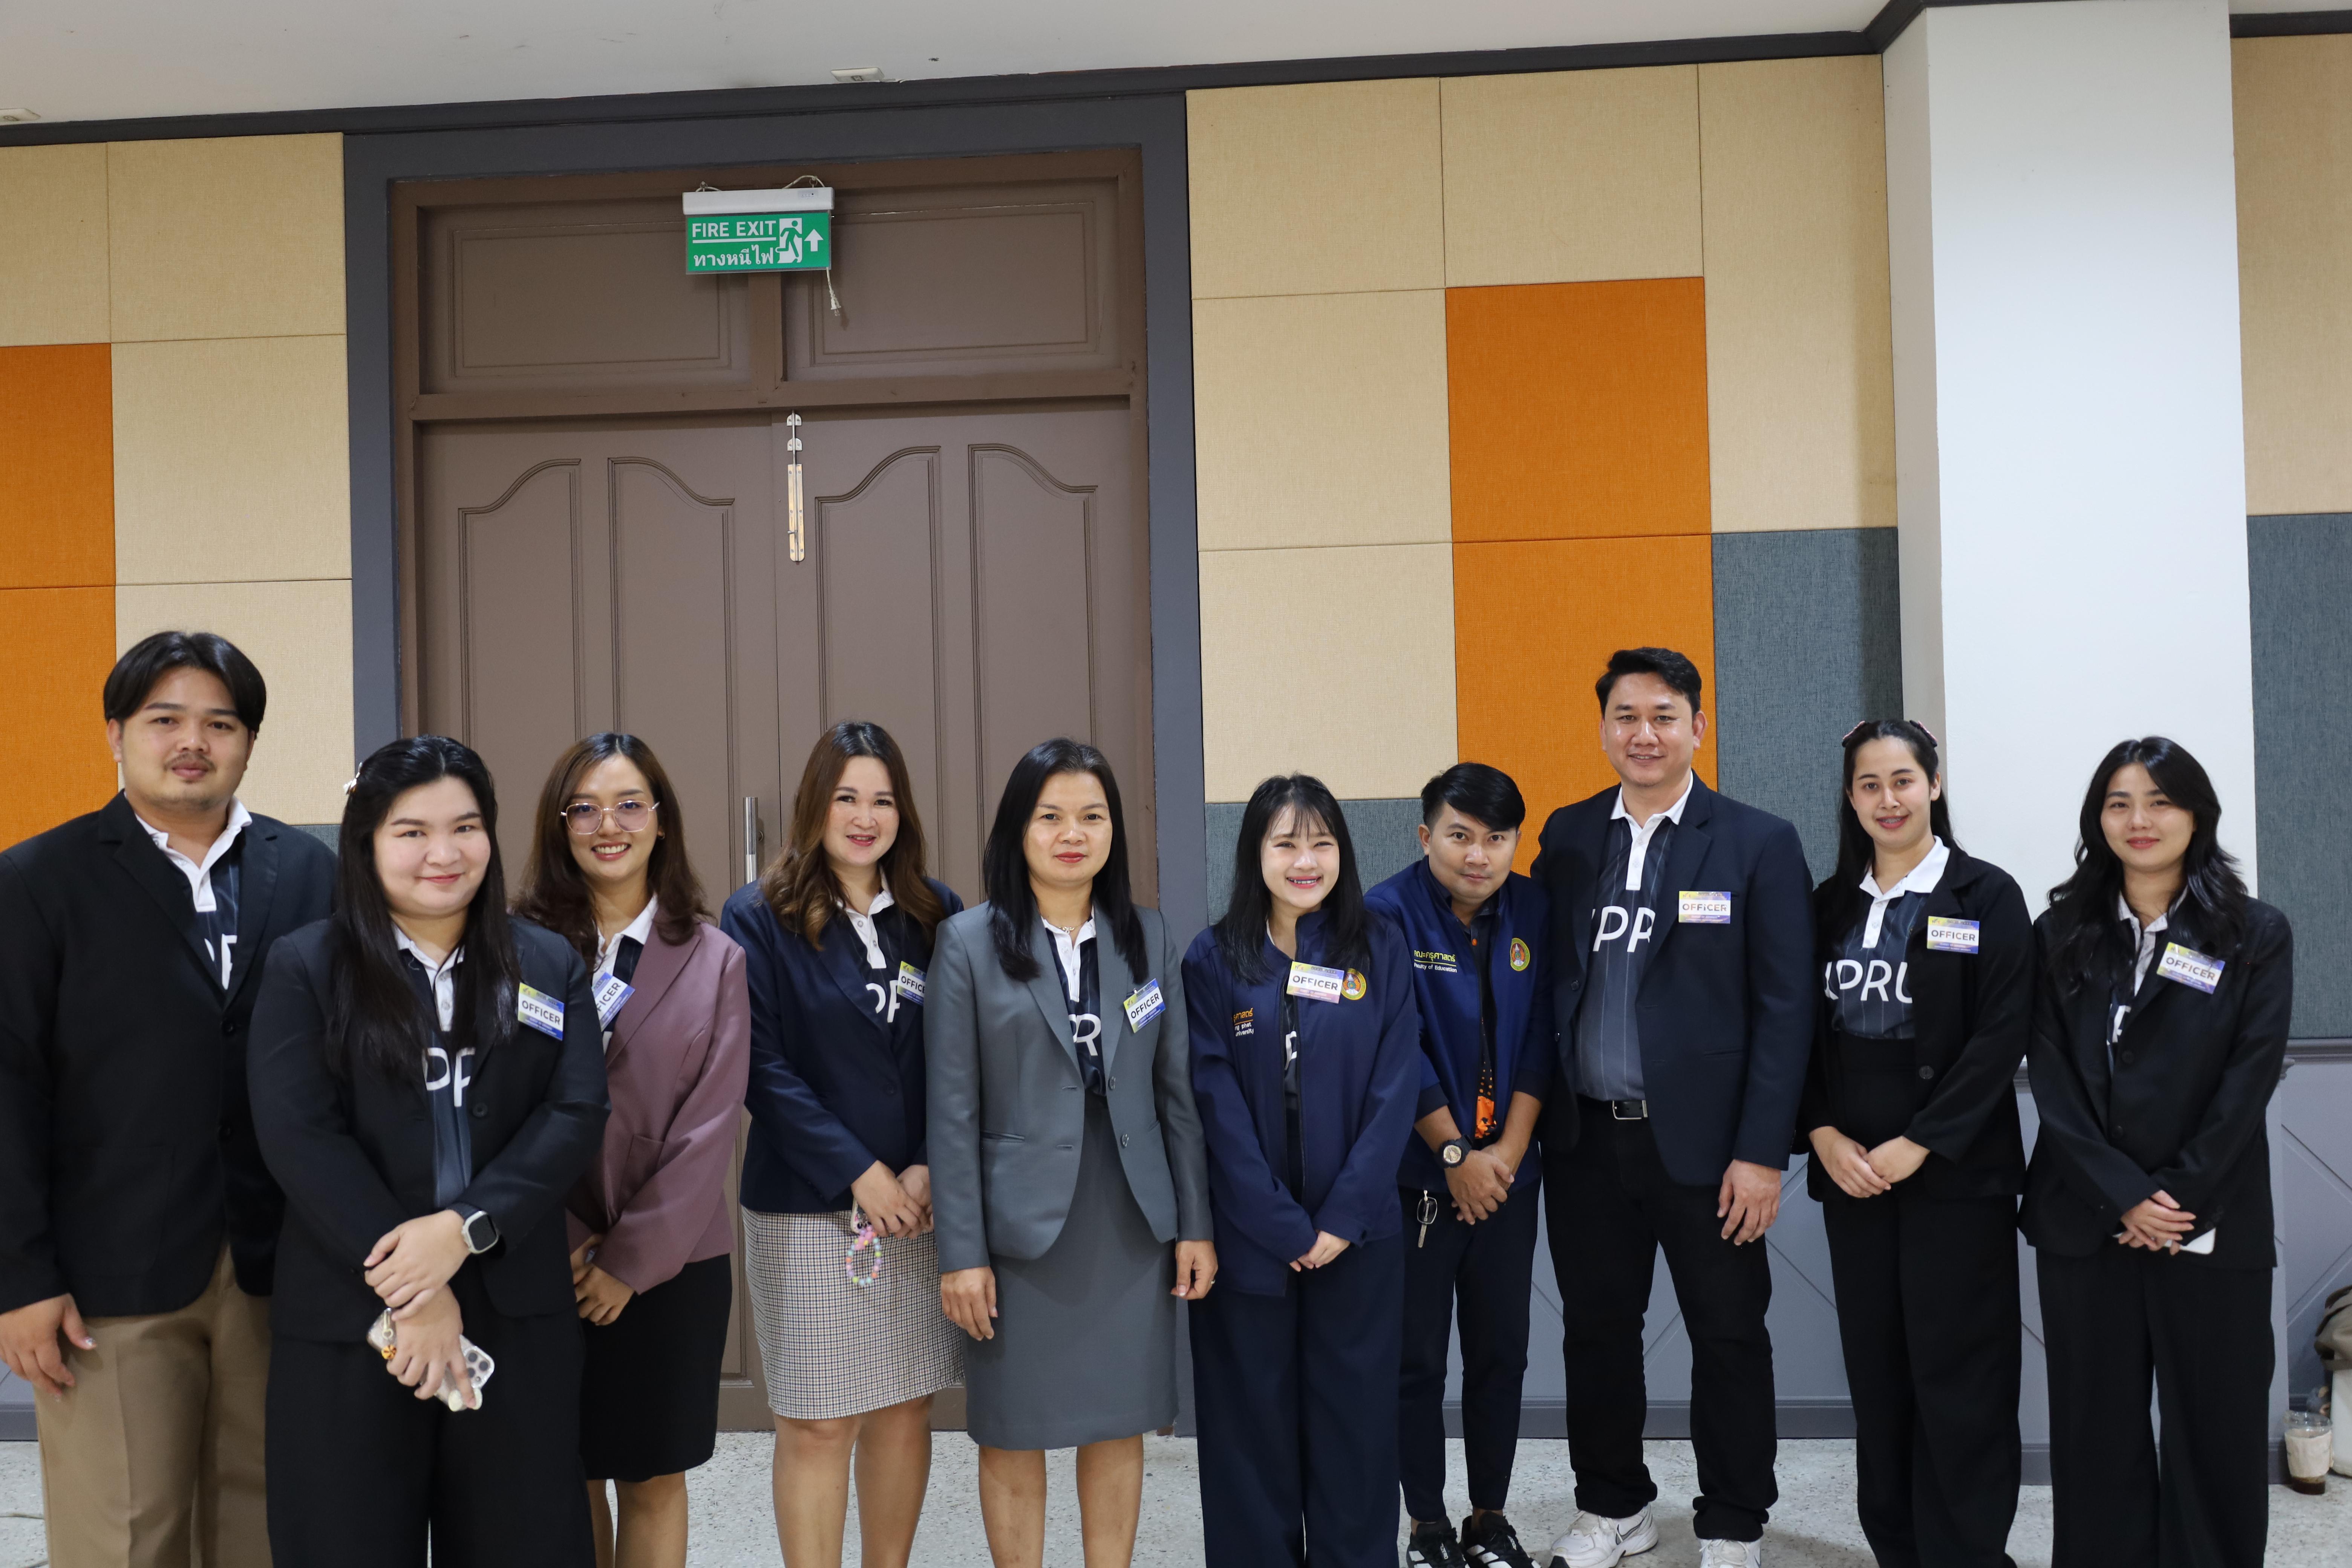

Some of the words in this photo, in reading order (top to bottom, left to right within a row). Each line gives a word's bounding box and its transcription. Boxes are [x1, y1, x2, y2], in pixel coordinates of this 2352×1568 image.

[692, 222, 729, 237] FIRE
[737, 220, 776, 236] EXIT
[694, 244, 773, 267] ทางหนีไฟ
[1591, 906, 1655, 952] PR
[1931, 930, 1975, 941] OFFICER
[2166, 957, 2216, 980] OFFICER
[901, 976, 925, 993] OFFICE
[1293, 975, 1338, 991] OFFICER
[596, 982, 621, 1012] FICER
[1131, 993, 1159, 1019] OFFICER
[522, 1000, 560, 1025] OFFICER
